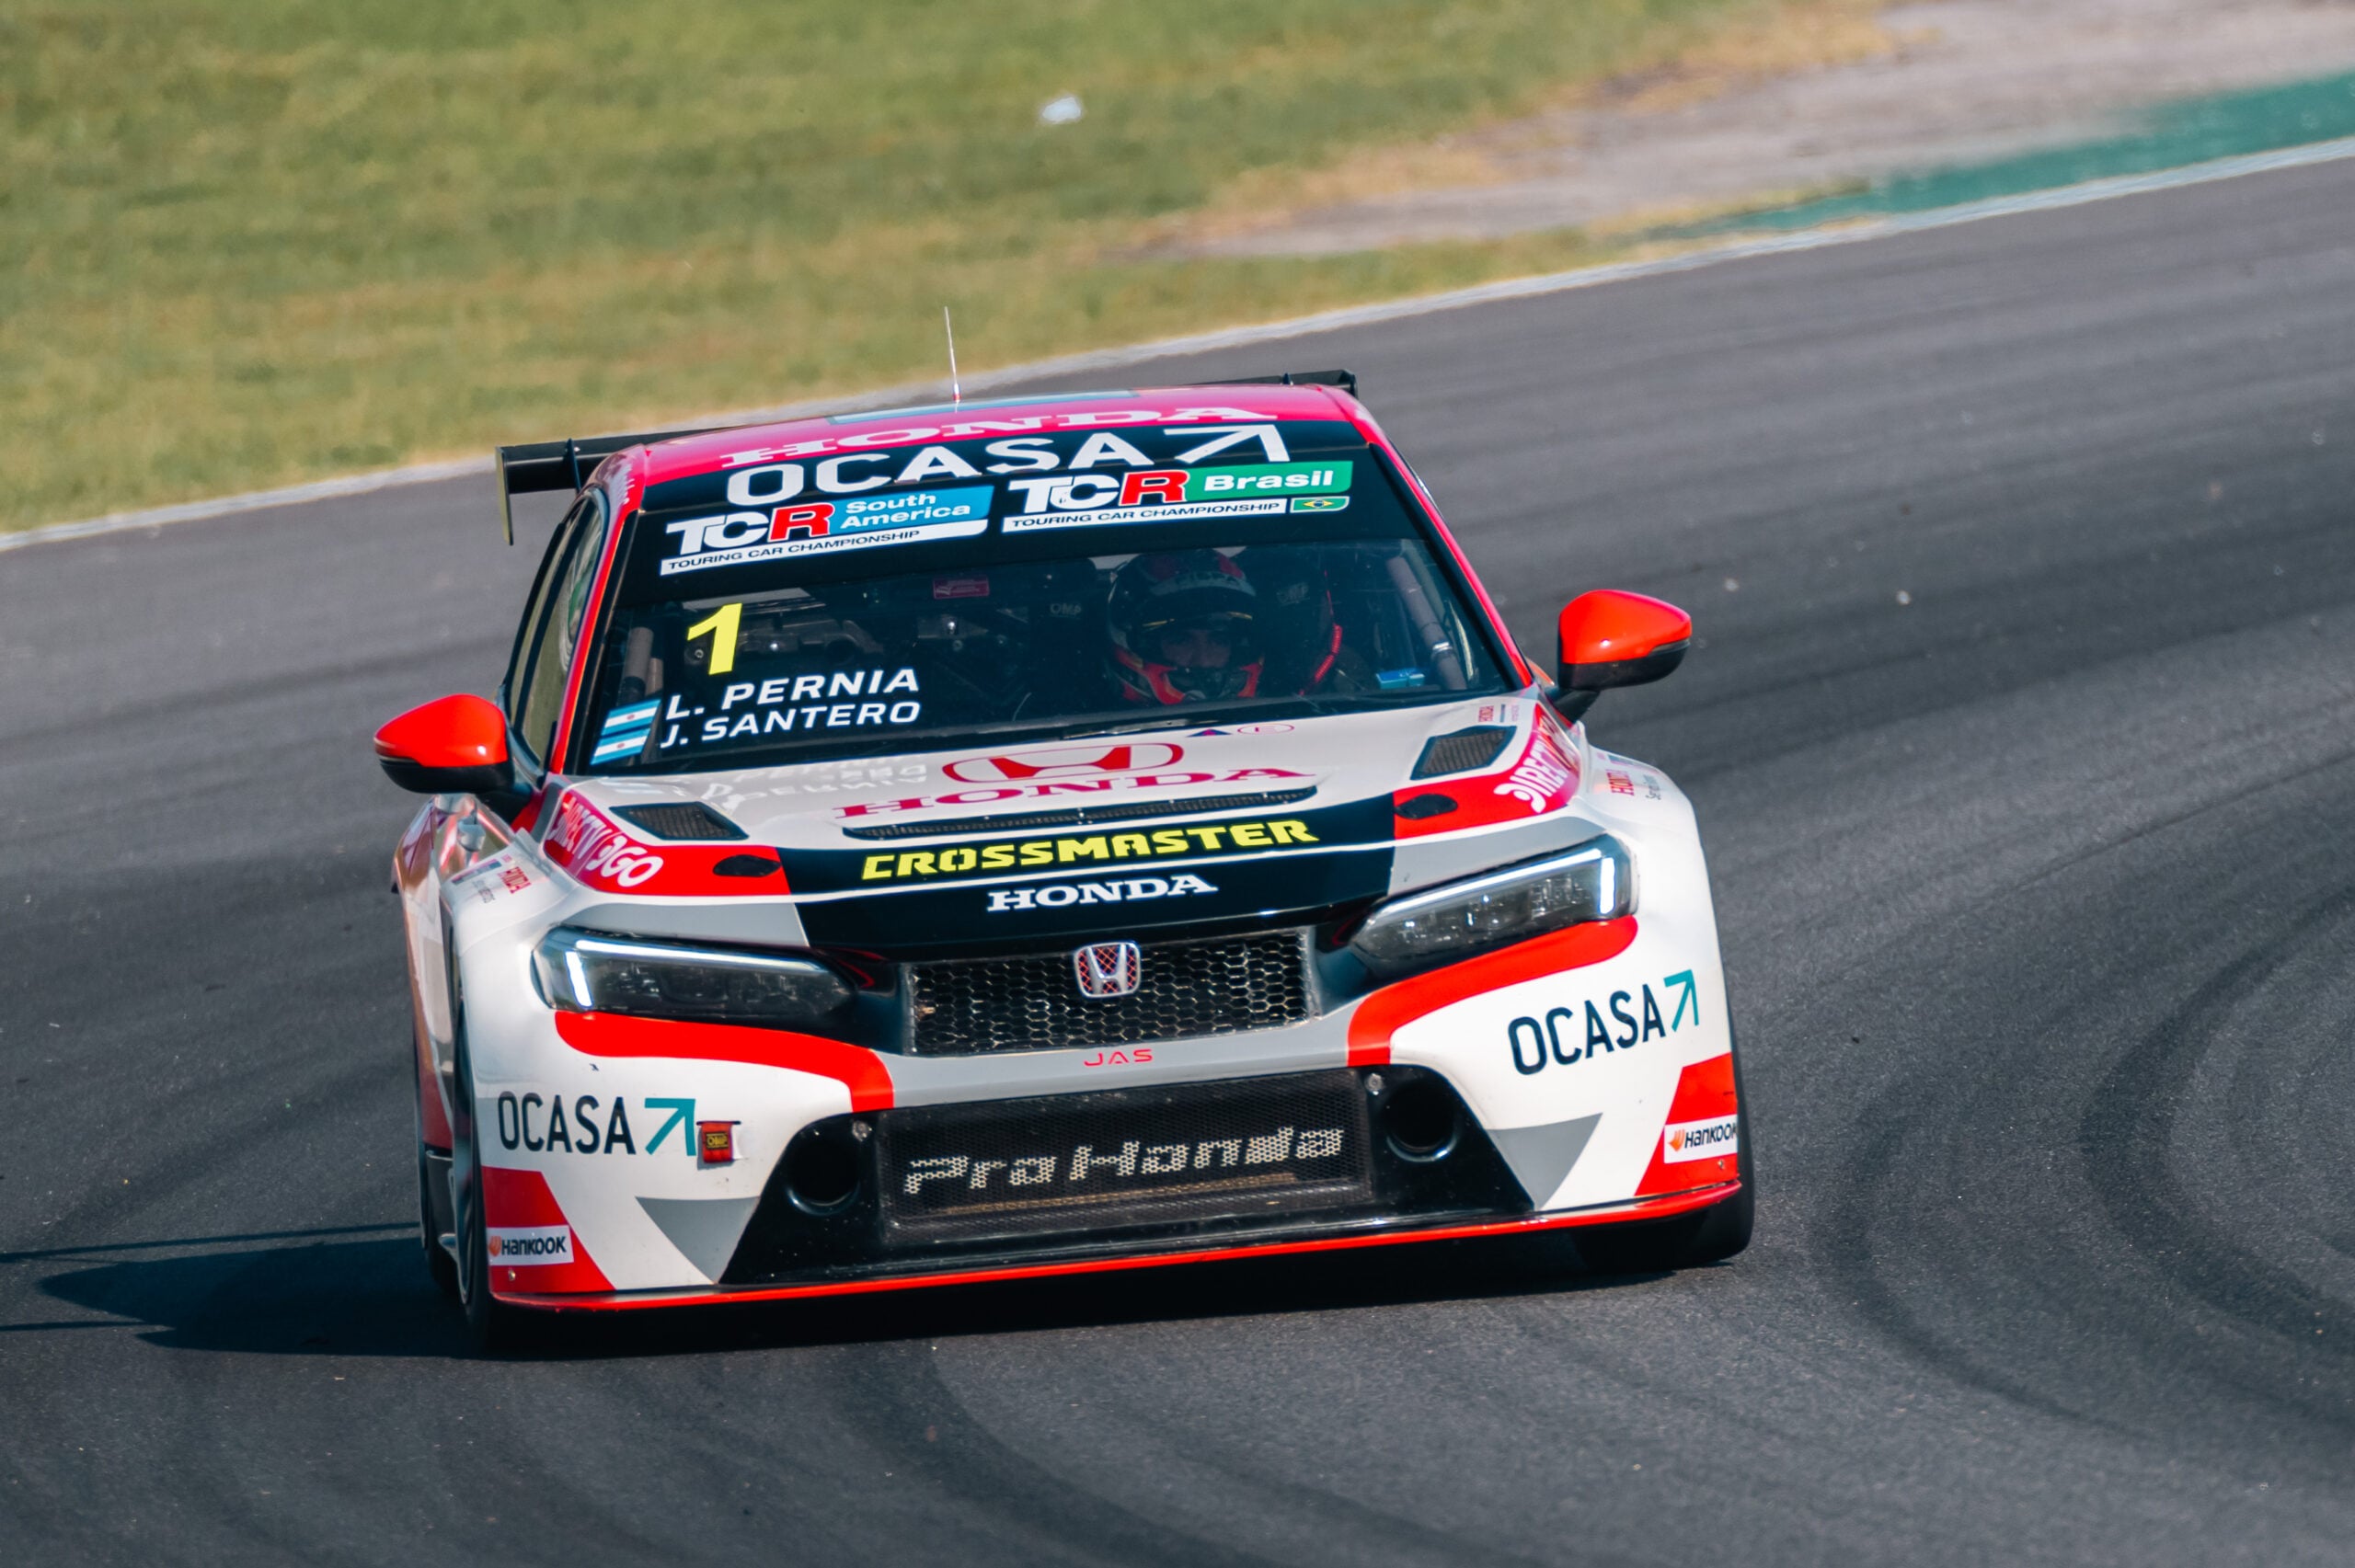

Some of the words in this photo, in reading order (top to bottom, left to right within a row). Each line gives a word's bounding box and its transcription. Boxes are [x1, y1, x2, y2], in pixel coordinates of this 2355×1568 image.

[719, 406, 1278, 466] HONDA
[727, 431, 1155, 505] OCASA
[1008, 470, 1190, 513] TCR
[1203, 470, 1334, 492] Brasil
[665, 502, 835, 555] TCR
[840, 503, 971, 530] America
[845, 492, 937, 514] South
[1012, 514, 1093, 528] TOURING
[1097, 511, 1135, 521] CAR
[1140, 502, 1281, 518] CHAMPIONSHIP
[669, 552, 743, 570] TOURING
[747, 546, 784, 559] CAR
[787, 530, 921, 553] CHAMPIONSHIP
[687, 602, 742, 675] 1
[665, 694, 705, 721] L.
[721, 669, 919, 711] PERNIA
[660, 724, 688, 749] J.
[701, 702, 921, 741] SANTERO
[832, 767, 1317, 818] HONDA
[861, 819, 1320, 880] CROSSMASTER
[986, 874, 1219, 912] HONDA
[1508, 982, 1666, 1075] OCASA
[1084, 1048, 1154, 1067] JAS
[498, 1091, 637, 1155] OCASA
[903, 1154, 1057, 1195] Pro
[1069, 1127, 1345, 1182] Honda
